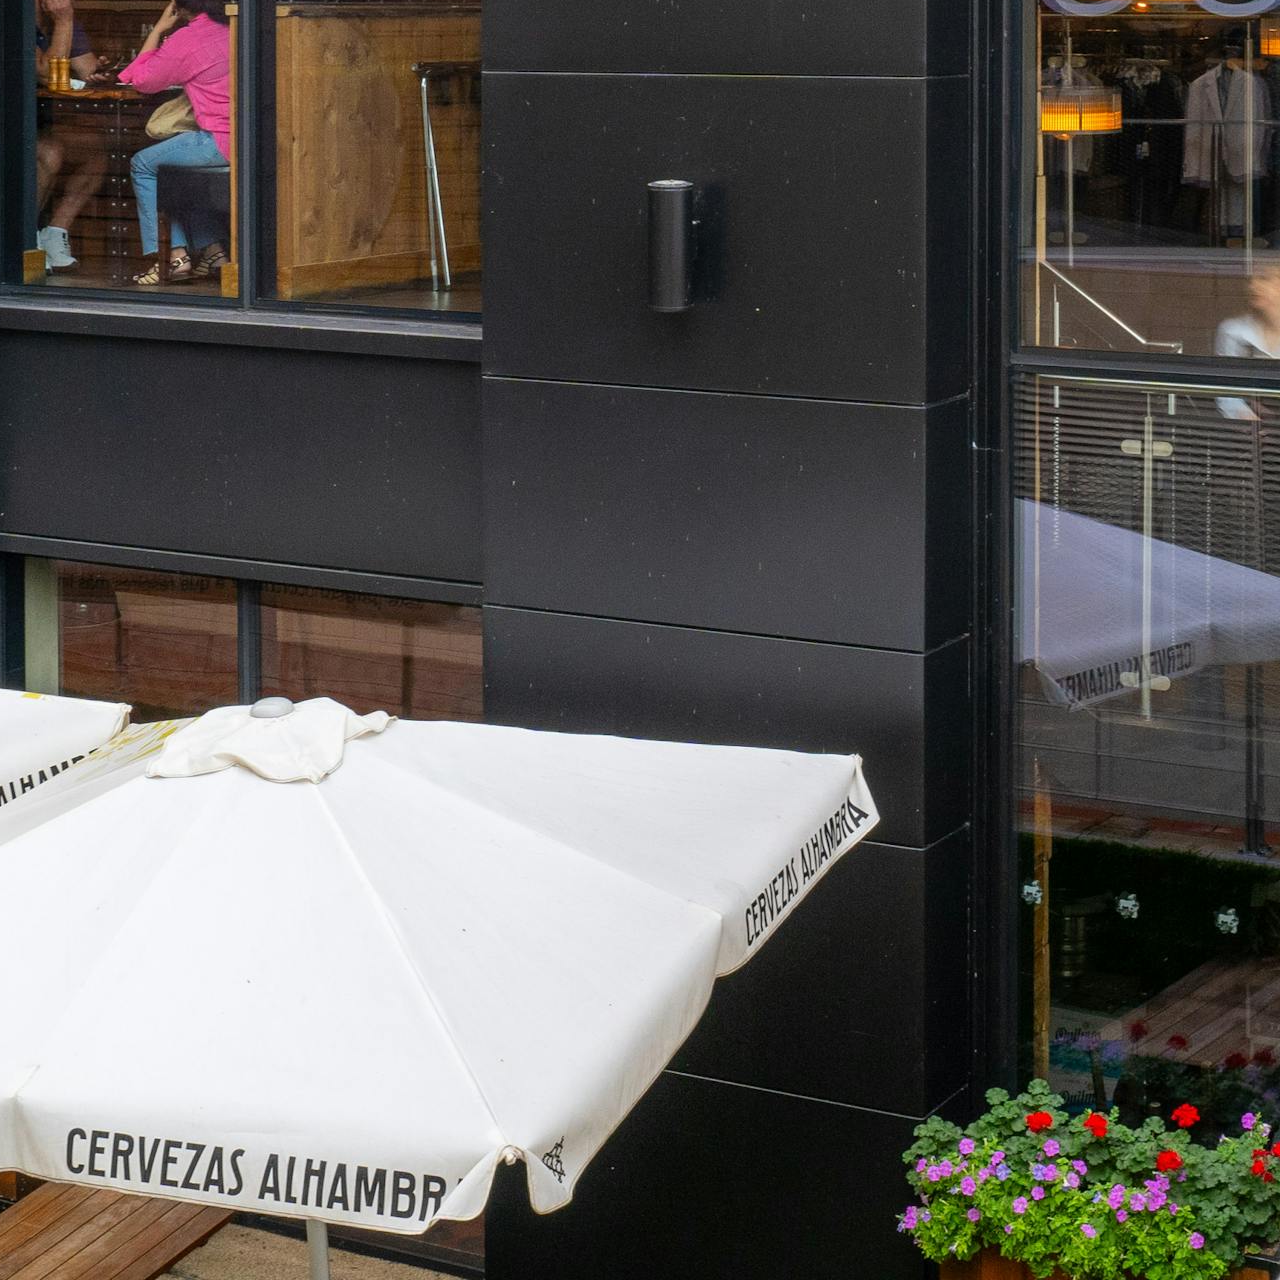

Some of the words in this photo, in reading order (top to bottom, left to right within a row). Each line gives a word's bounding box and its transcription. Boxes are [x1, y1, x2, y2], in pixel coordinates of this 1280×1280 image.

[744, 857, 799, 947] CERVEZAS
[800, 795, 869, 886] ALHAMBRA
[66, 1127, 246, 1197] CERVEZAS
[257, 1153, 463, 1222] ALHAMBR
